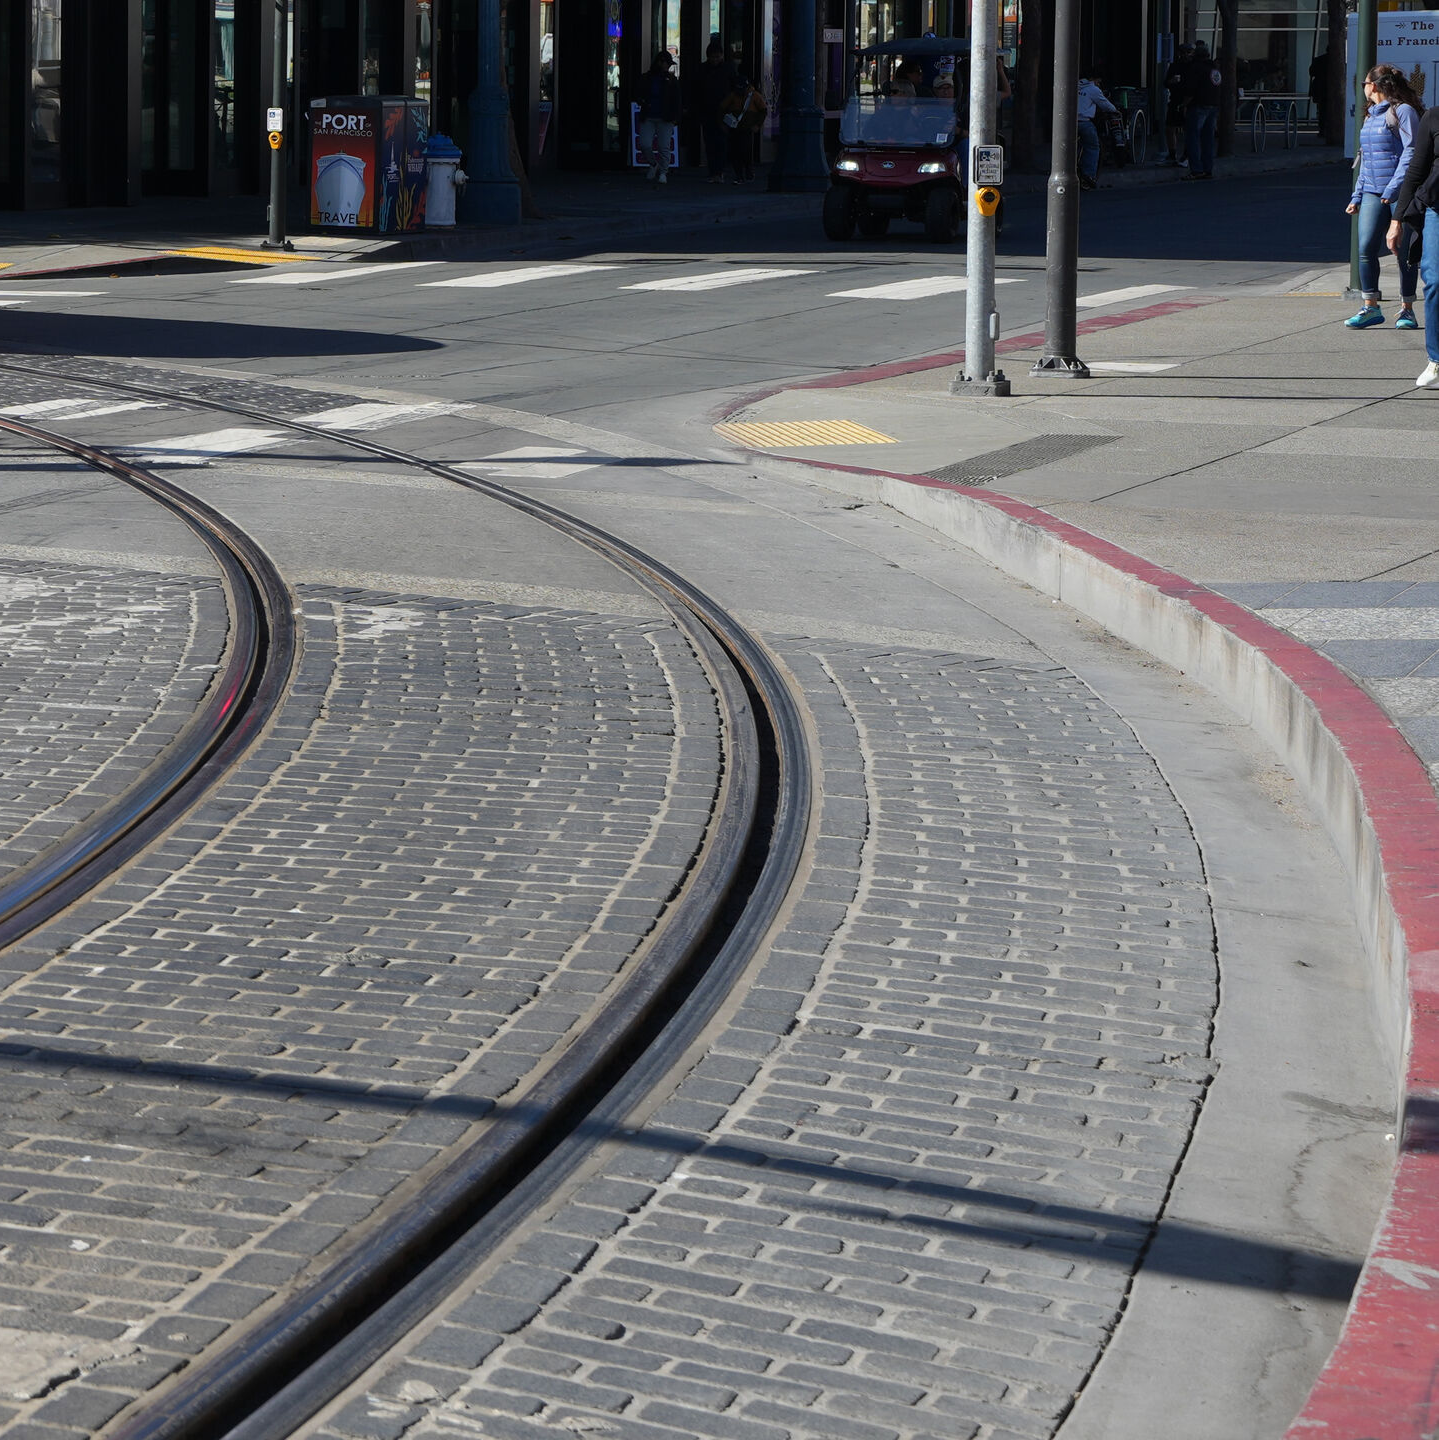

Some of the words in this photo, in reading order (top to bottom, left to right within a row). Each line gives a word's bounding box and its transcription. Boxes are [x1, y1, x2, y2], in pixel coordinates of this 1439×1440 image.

[1410, 21, 1435, 31] The
[322, 113, 366, 131] PORT
[330, 128, 373, 137] FRANCISCO
[318, 211, 362, 225] TRAVEL
